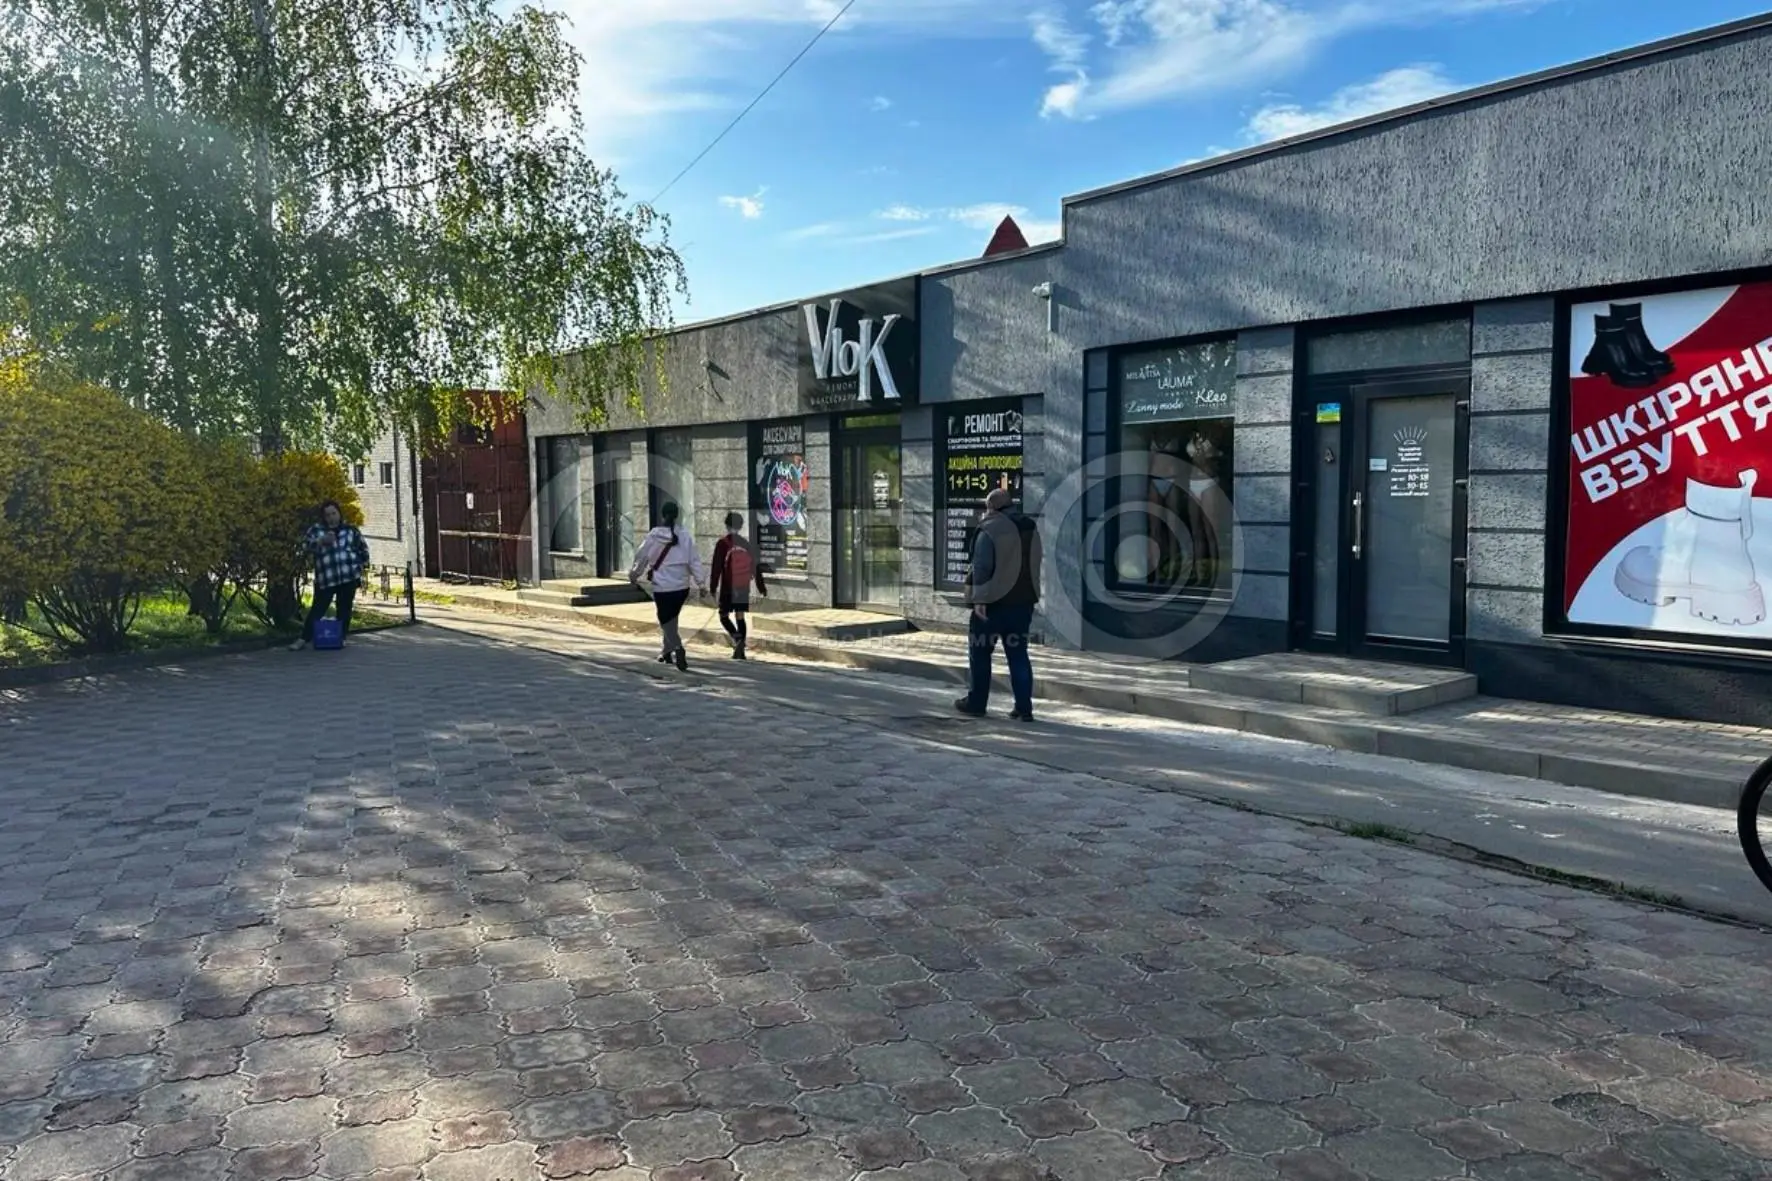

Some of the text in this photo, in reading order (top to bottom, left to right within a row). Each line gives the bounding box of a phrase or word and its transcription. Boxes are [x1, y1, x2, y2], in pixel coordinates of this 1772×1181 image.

[1158, 375, 1194, 389] LAUMA
[964, 413, 1004, 434] РЕМОНТ
[1580, 382, 1772, 503] ВЗУТТЯ
[948, 473, 987, 490] 1+1=3
